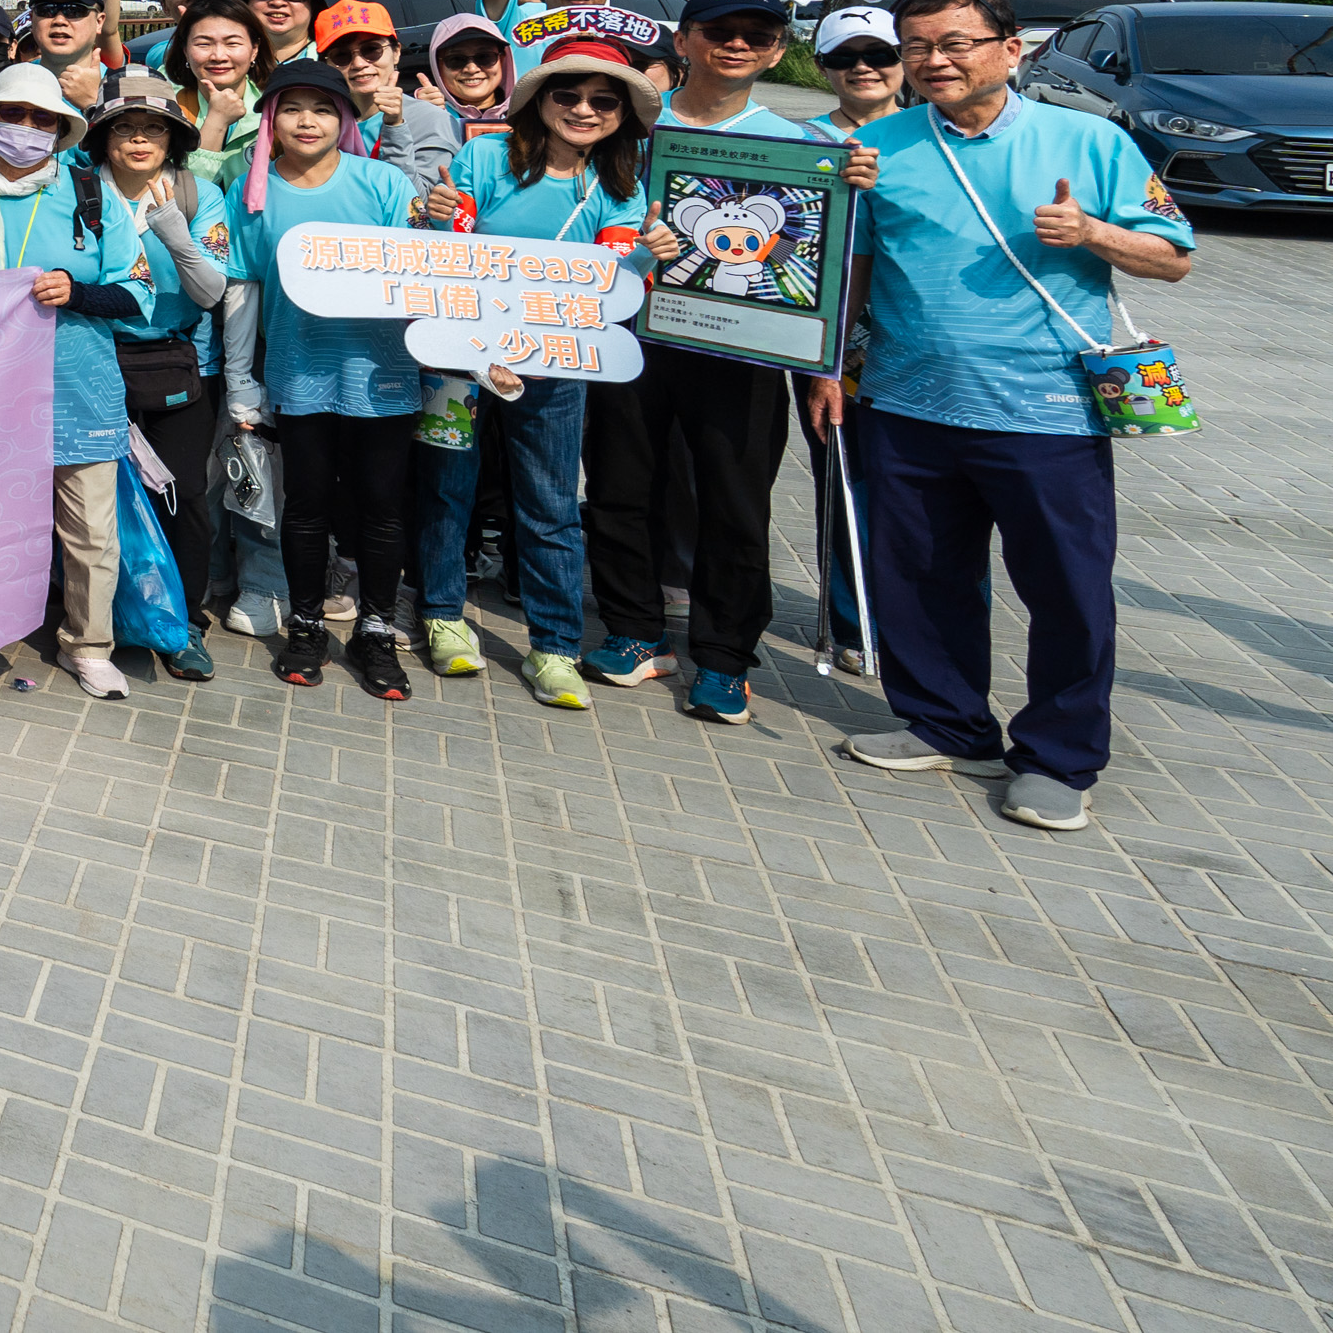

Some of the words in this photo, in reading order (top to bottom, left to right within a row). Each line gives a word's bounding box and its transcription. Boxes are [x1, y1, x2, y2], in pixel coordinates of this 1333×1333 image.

[516, 8, 652, 46] 菸蒂不落地
[299, 233, 619, 292] 源頭減塑好easy
